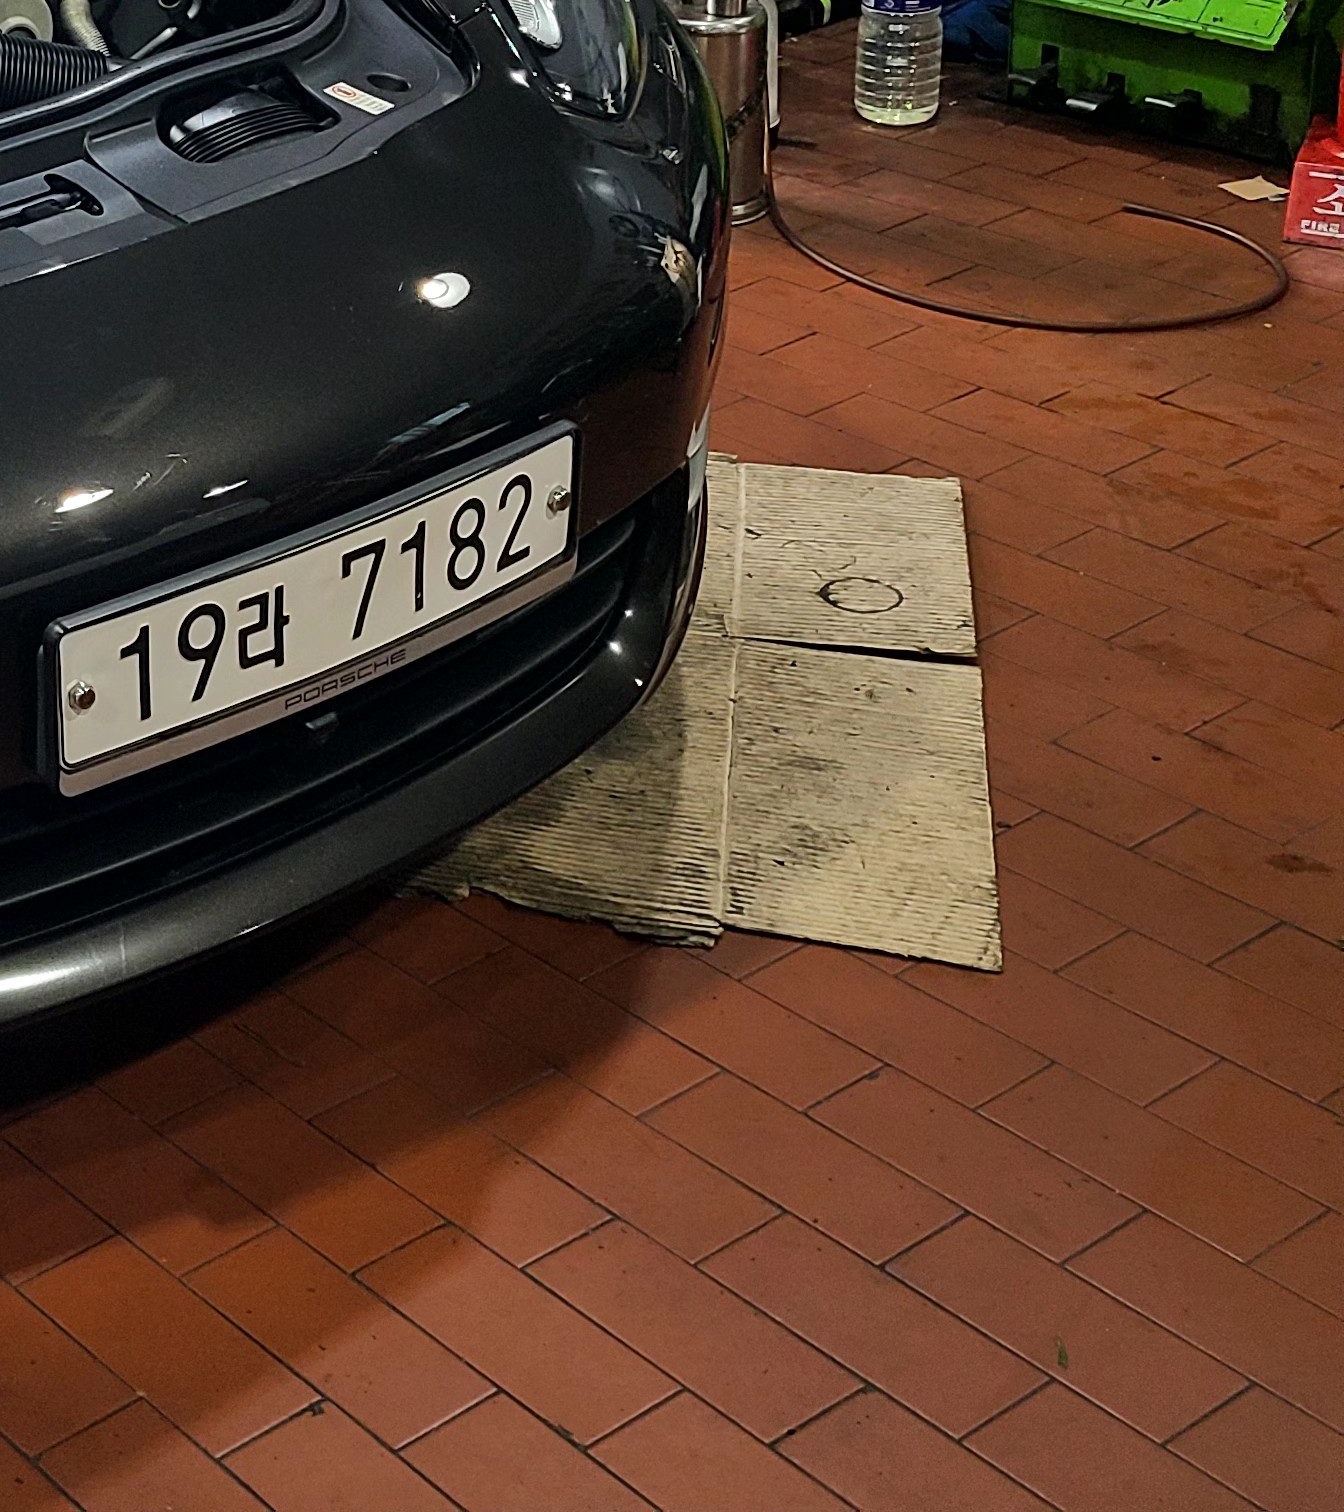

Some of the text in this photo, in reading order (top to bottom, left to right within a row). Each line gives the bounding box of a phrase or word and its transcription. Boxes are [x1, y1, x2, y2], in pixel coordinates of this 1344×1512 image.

[1300, 219, 1340, 234] FIRE
[119, 473, 533, 721] 19라 7182
[284, 648, 408, 712] PORSCHE
